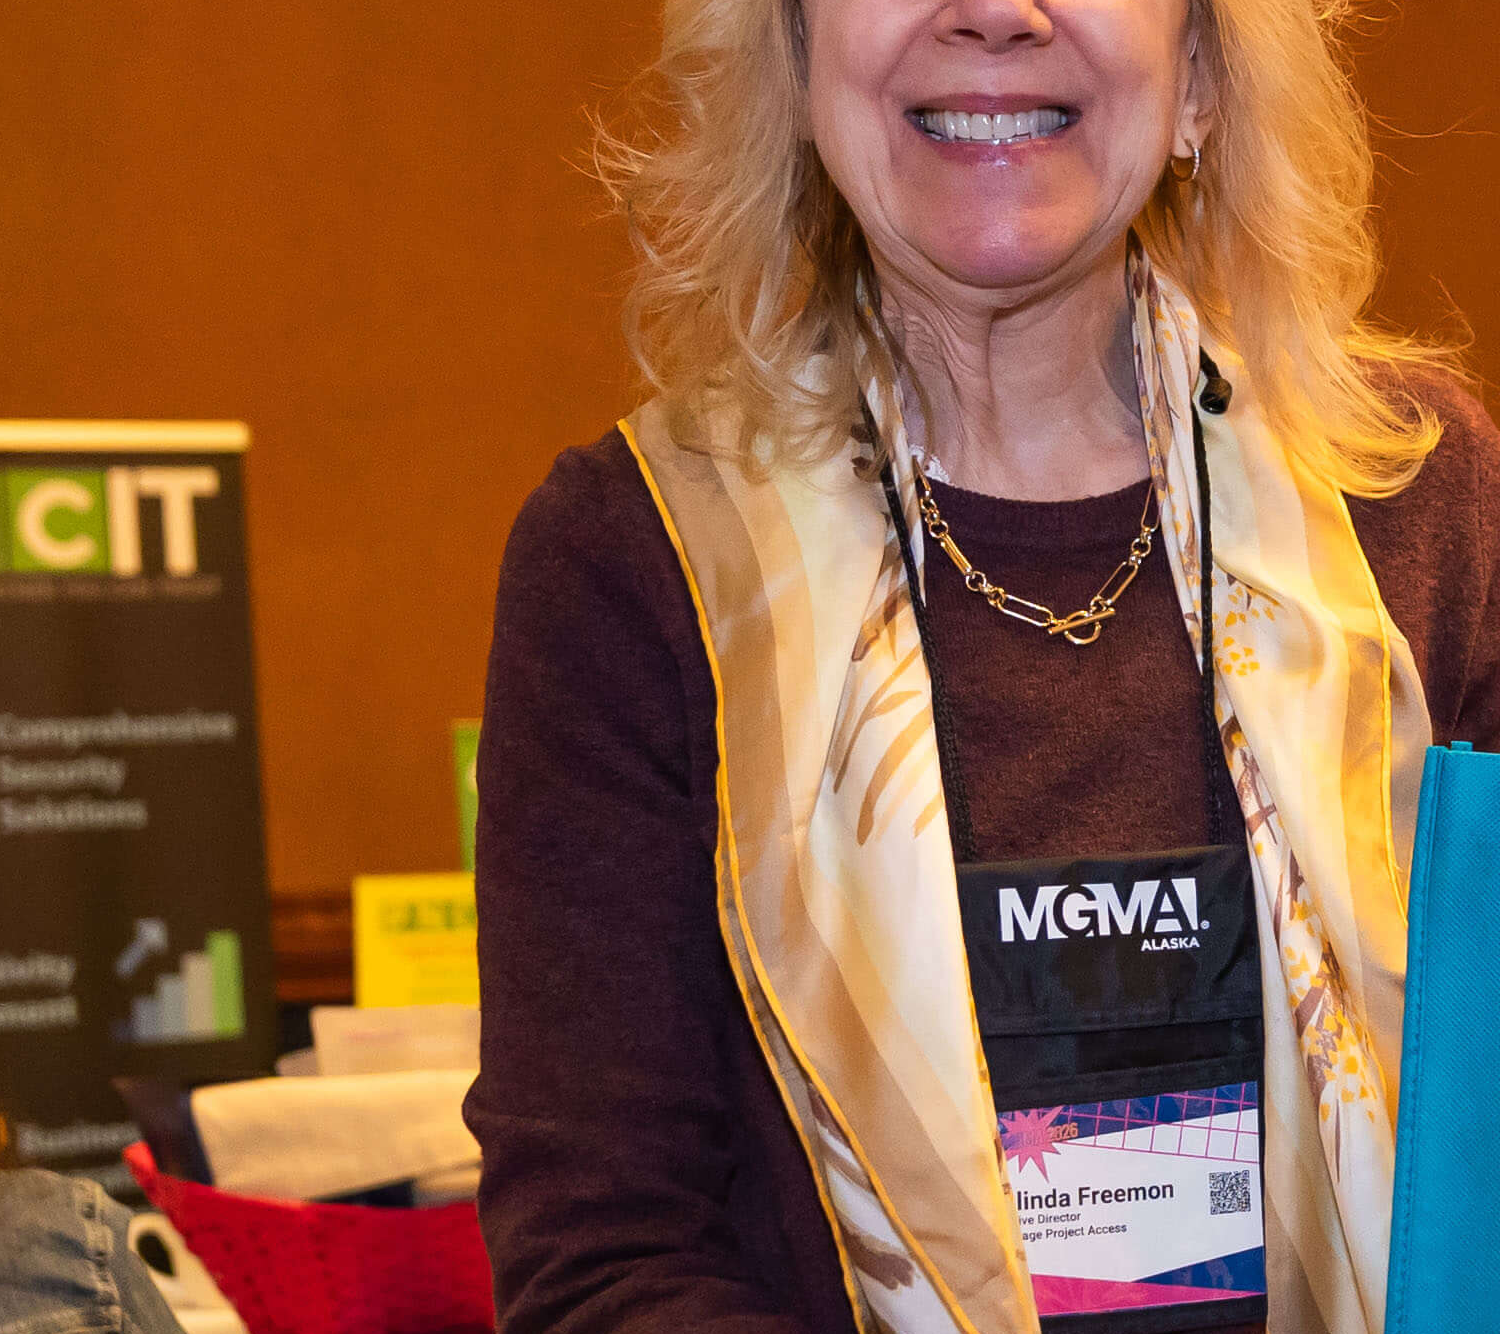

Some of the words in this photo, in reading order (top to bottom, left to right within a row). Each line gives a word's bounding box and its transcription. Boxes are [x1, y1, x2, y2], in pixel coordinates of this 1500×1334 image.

[999, 878, 1199, 943] MGMA
[1141, 937, 1200, 952] ALASKA
[1078, 1183, 1174, 1207] Freemon
[1037, 1212, 1081, 1225] Director
[1046, 1227, 1085, 1241] Project
[1088, 1223, 1128, 1236] Access
